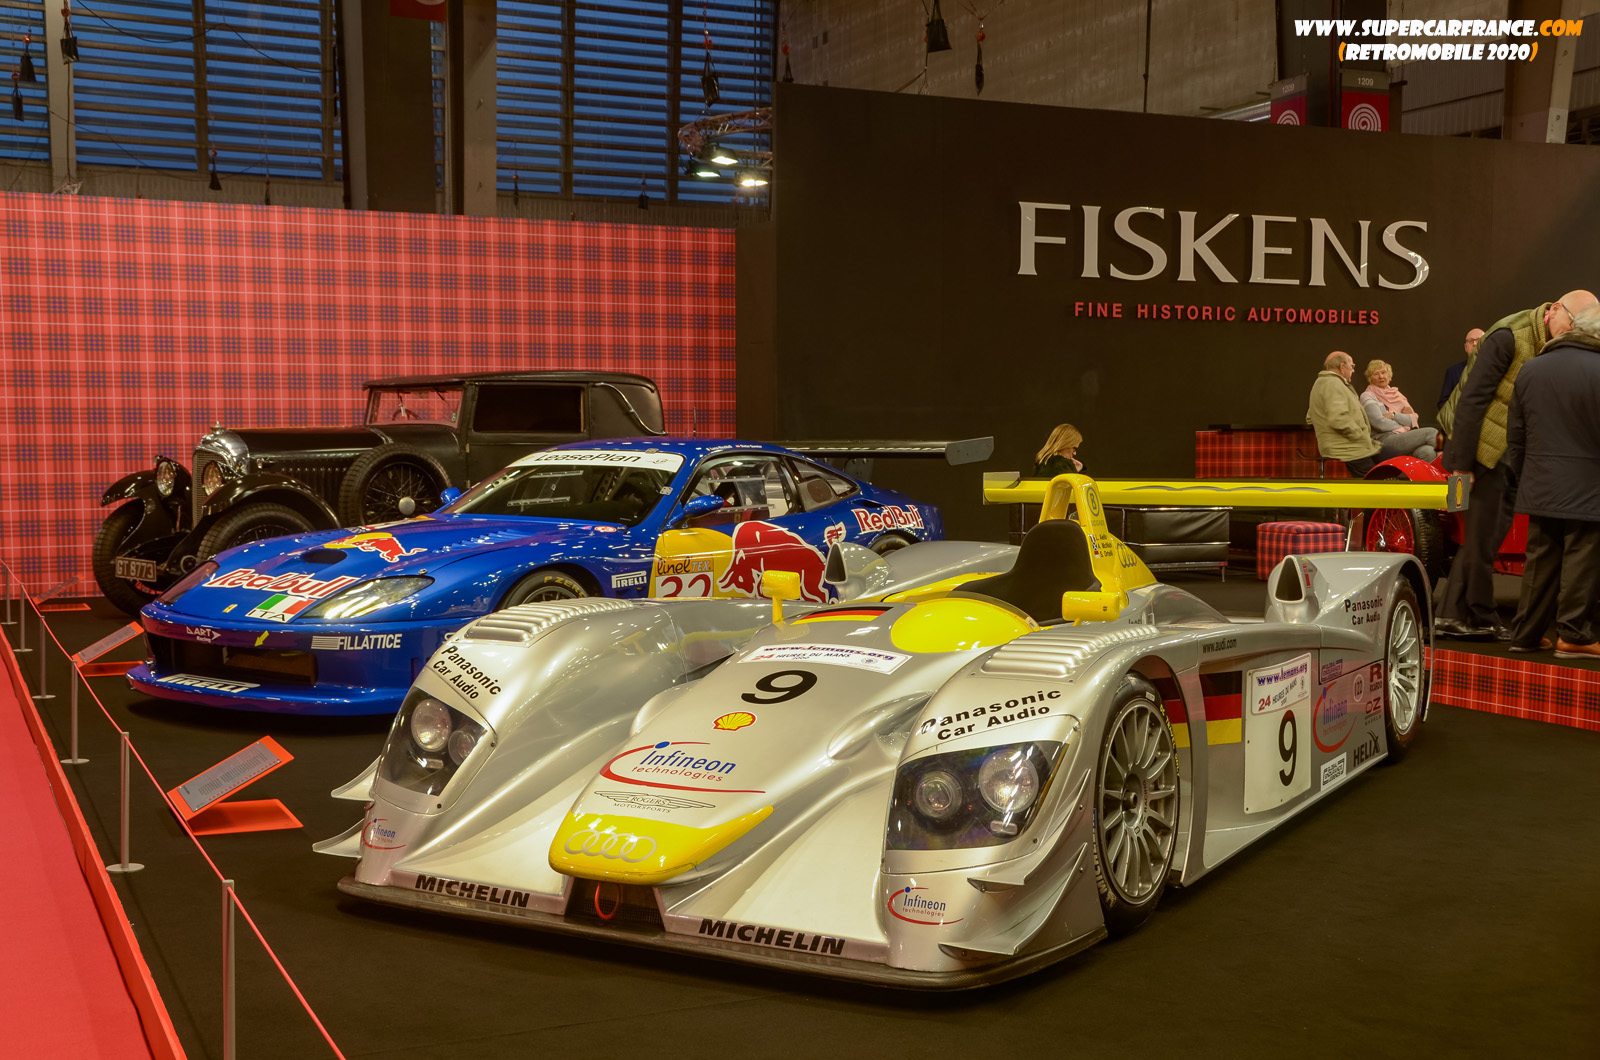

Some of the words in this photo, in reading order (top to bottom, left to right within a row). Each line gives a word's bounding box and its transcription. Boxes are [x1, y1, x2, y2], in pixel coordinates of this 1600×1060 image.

[1357, 77, 1374, 86] 1209
[1017, 201, 1430, 290] FISKENS
[1074, 302, 1123, 318] FINE
[1137, 304, 1236, 322] HISTORIC
[1248, 307, 1380, 325] AUTOMOBILES
[534, 452, 642, 463] LeasePlan
[851, 506, 897, 534] Red
[888, 504, 925, 529] Bull
[117, 560, 128, 575] GT
[130, 561, 154, 578] 8773
[203, 568, 299, 589] Red
[262, 572, 361, 599] Bull
[611, 570, 647, 589] PIRELLI
[1344, 595, 1384, 613] Panasonic
[246, 608, 287, 622] ITA
[1351, 614, 1364, 626] Car
[1366, 611, 1381, 624] Audio
[337, 633, 403, 650] FILLATTICE
[1202, 638, 1237, 654] www.audi.com
[763, 645, 897, 661] www.lemans.org
[433, 660, 452, 676] Car
[449, 673, 479, 699] Audio
[441, 645, 502, 695] Panasonic
[1256, 662, 1308, 686] www.lemans.org
[1369, 663, 1382, 682] R
[156, 673, 260, 693] PIRELLI
[741, 669, 818, 705] 9
[920, 690, 1062, 735] Panasonic
[1258, 695, 1272, 712] 24
[1365, 697, 1382, 714] OZ
[937, 723, 976, 740] Car
[986, 706, 1050, 728] Audio
[1278, 709, 1298, 787] 9
[1353, 732, 1381, 767] HELIX
[639, 750, 737, 775] Infineon
[632, 766, 723, 782] technologies
[613, 803, 672, 813] MOTORSPORTS
[630, 796, 668, 806] ROGERS
[415, 874, 531, 908] MICHELIN
[902, 907, 945, 917] technologies
[903, 894, 946, 912] Infineon
[699, 918, 846, 956] MICHELIN
